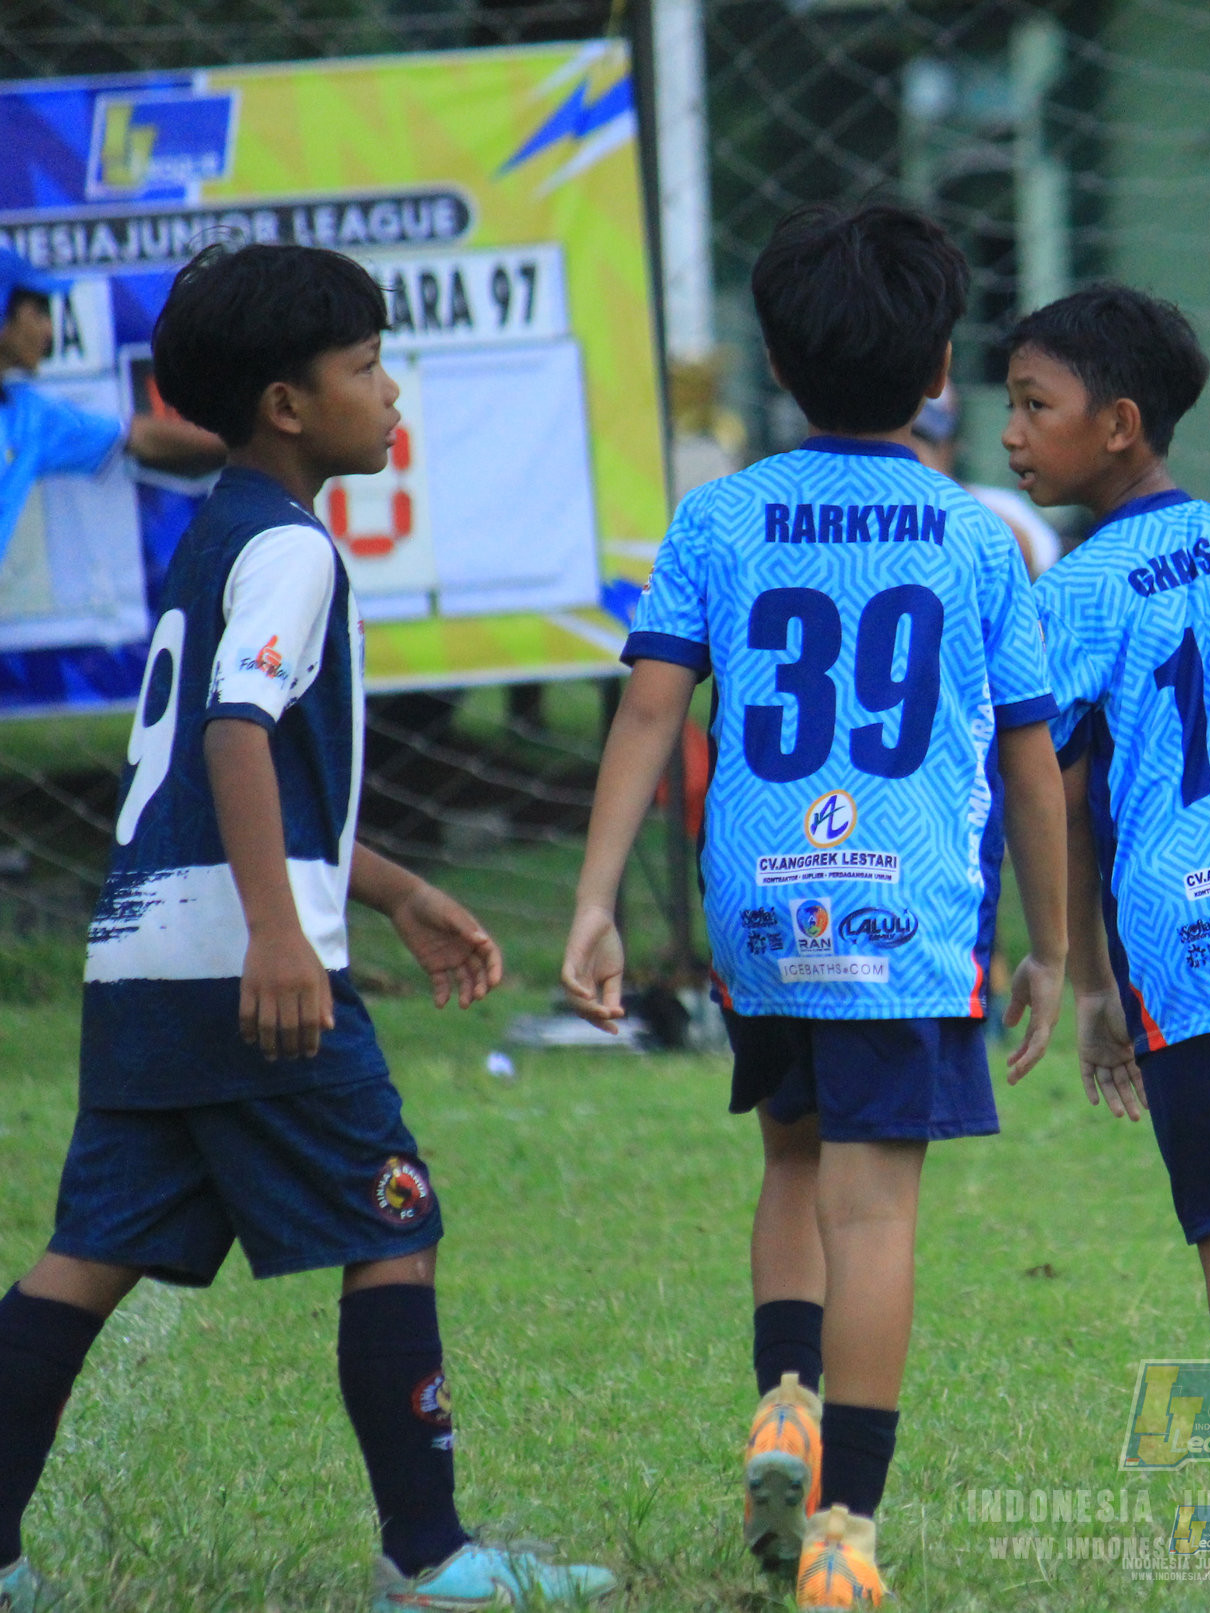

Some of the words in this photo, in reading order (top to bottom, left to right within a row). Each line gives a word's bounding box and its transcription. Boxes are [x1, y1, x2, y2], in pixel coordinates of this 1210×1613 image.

[293, 198, 456, 246] LEAGUE
[492, 261, 536, 327] 97
[765, 503, 947, 546] RARKYAN
[743, 584, 944, 783] 39
[116, 608, 184, 846] 9
[760, 853, 838, 870] CV.ANGGREK
[842, 853, 897, 869] LESTARI
[799, 938, 831, 949] RAN
[400, 1209, 416, 1220] FC
